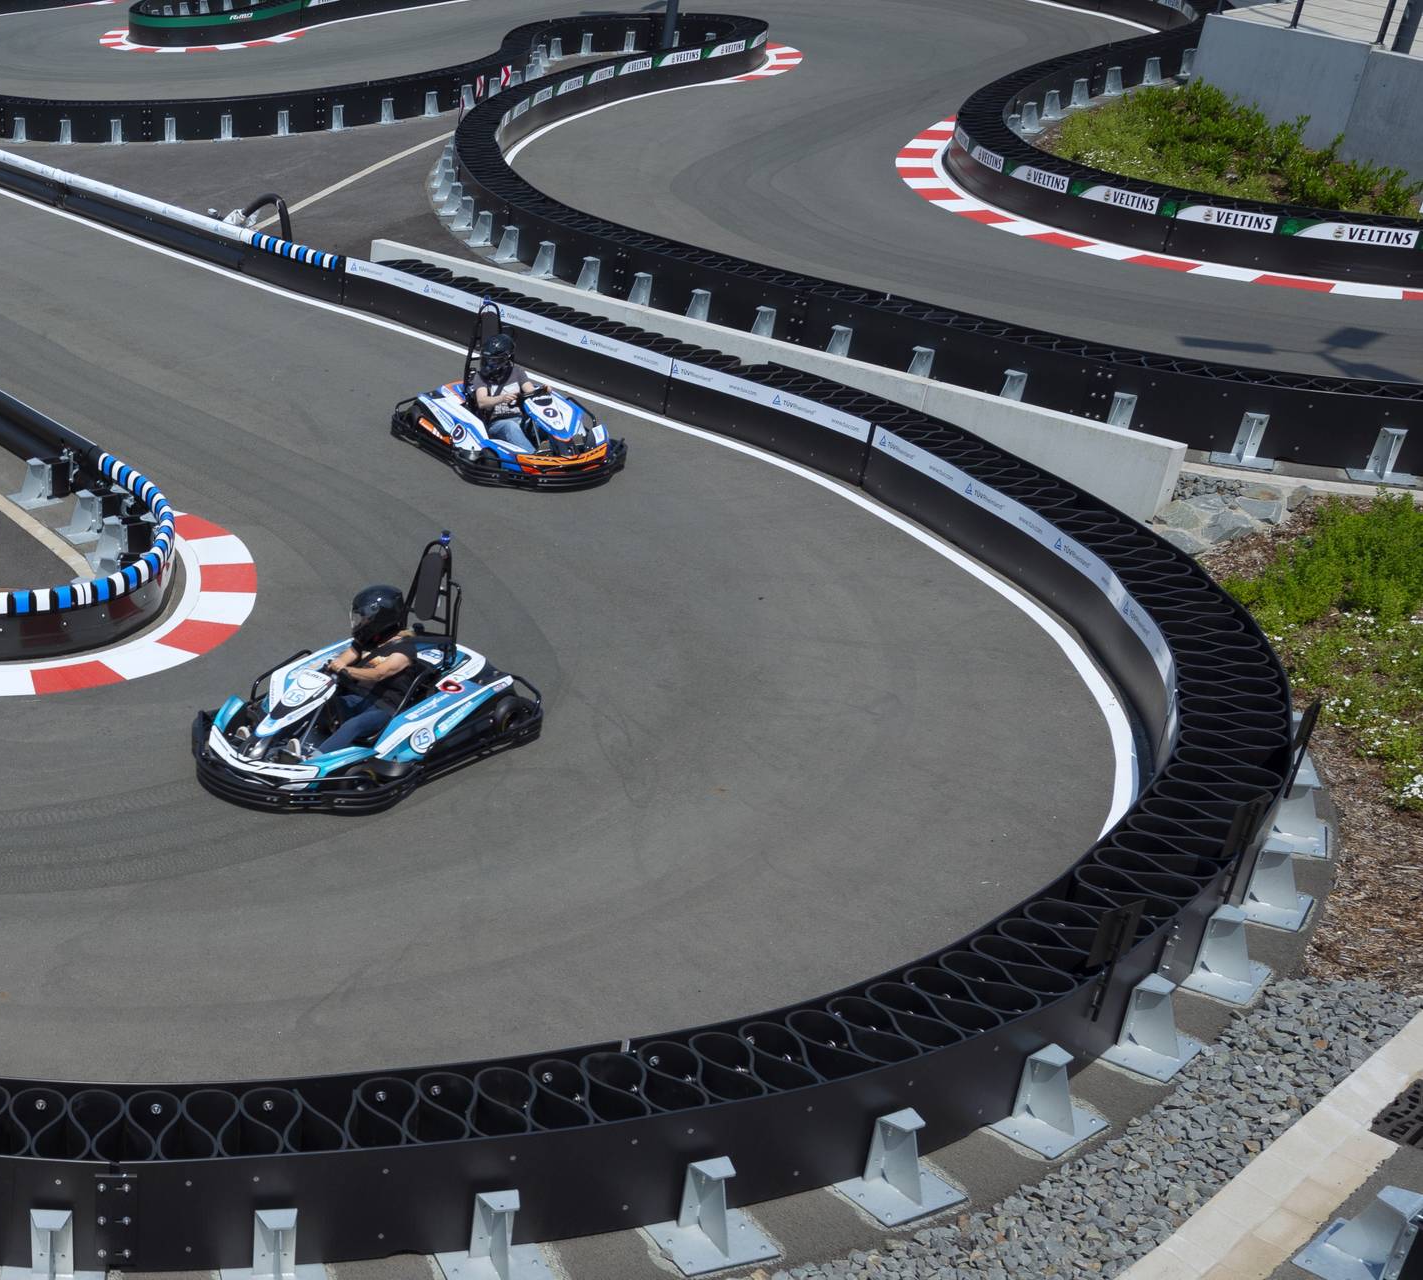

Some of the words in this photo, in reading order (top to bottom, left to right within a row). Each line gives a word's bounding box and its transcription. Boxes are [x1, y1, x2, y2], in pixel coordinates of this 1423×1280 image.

[725, 41, 745, 54] VELTINS
[630, 59, 652, 71] VELTINS
[676, 50, 700, 63] VELTINS
[981, 151, 1002, 170] VELTINS
[1032, 170, 1067, 190] VELTINS
[1112, 190, 1156, 211] VELTINS
[1215, 210, 1273, 231] VELTINS
[1347, 226, 1414, 246] VELTINS
[287, 691, 302, 703] 15
[416, 731, 430, 747] 15
